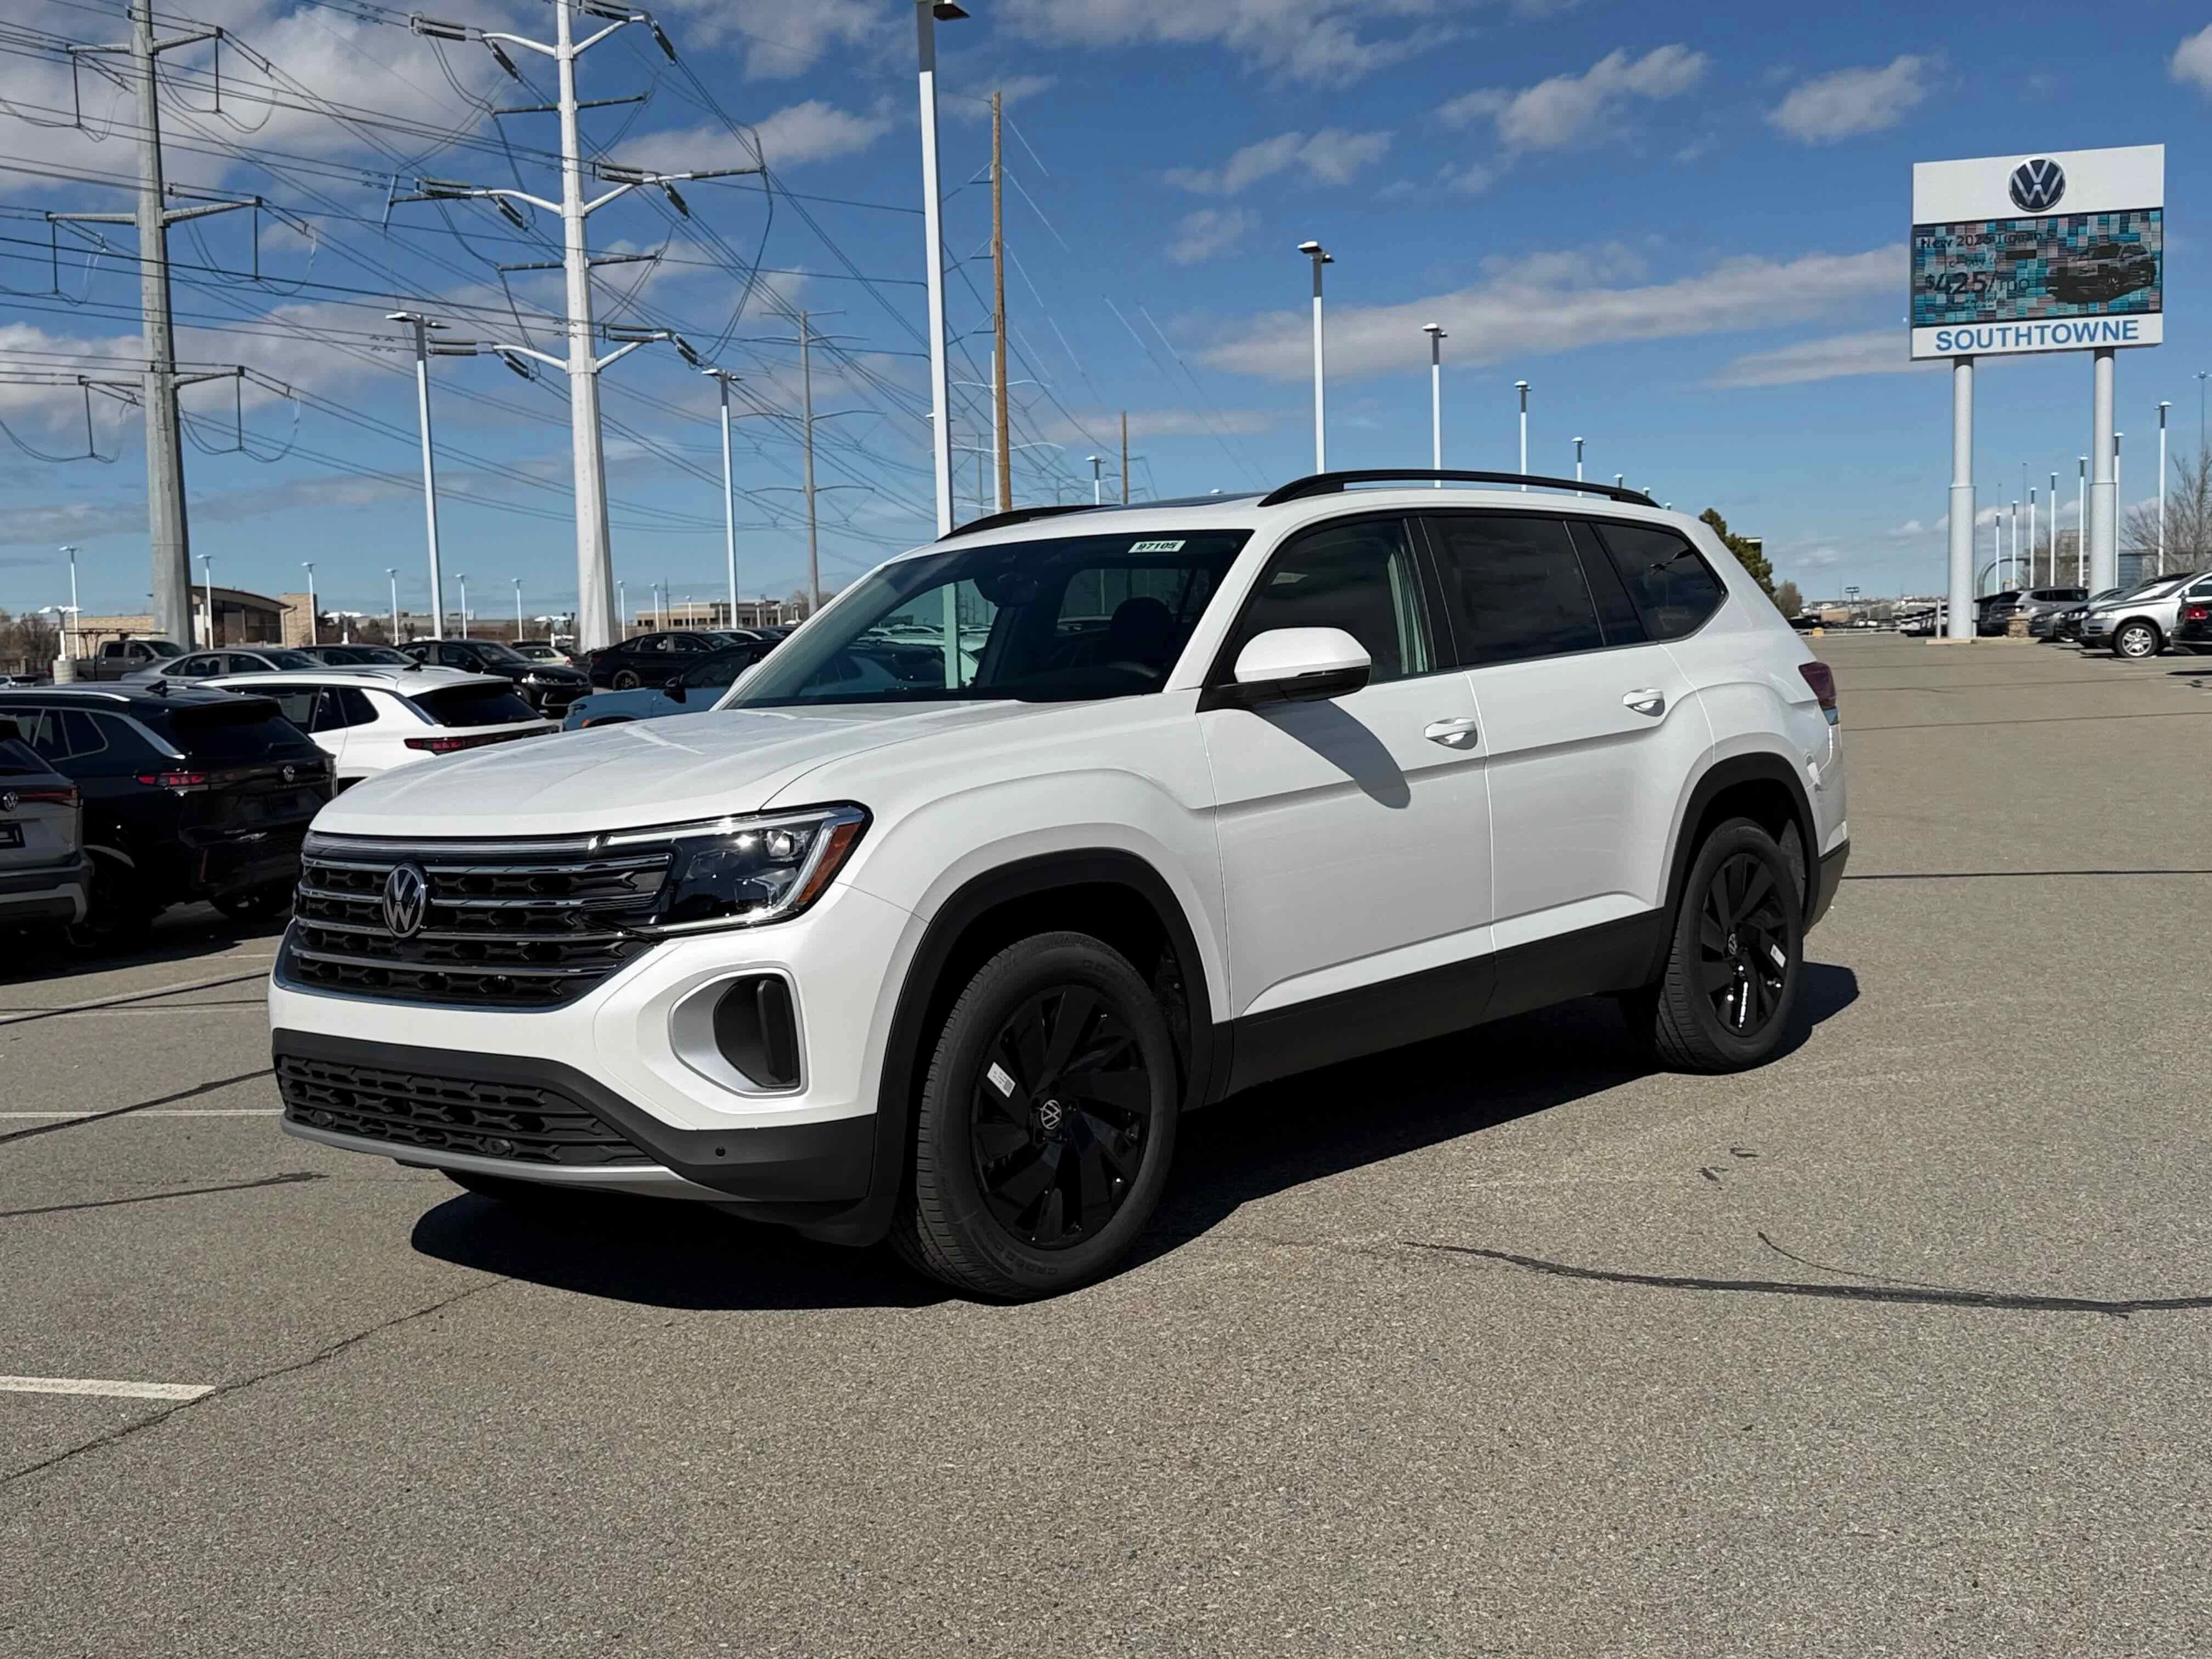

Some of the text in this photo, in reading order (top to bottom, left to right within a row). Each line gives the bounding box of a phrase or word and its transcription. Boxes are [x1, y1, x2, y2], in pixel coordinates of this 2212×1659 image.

[2009, 156, 2066, 212] VW
[1936, 320, 2139, 351] SOUTHTOWNE
[383, 867, 425, 938] VW
